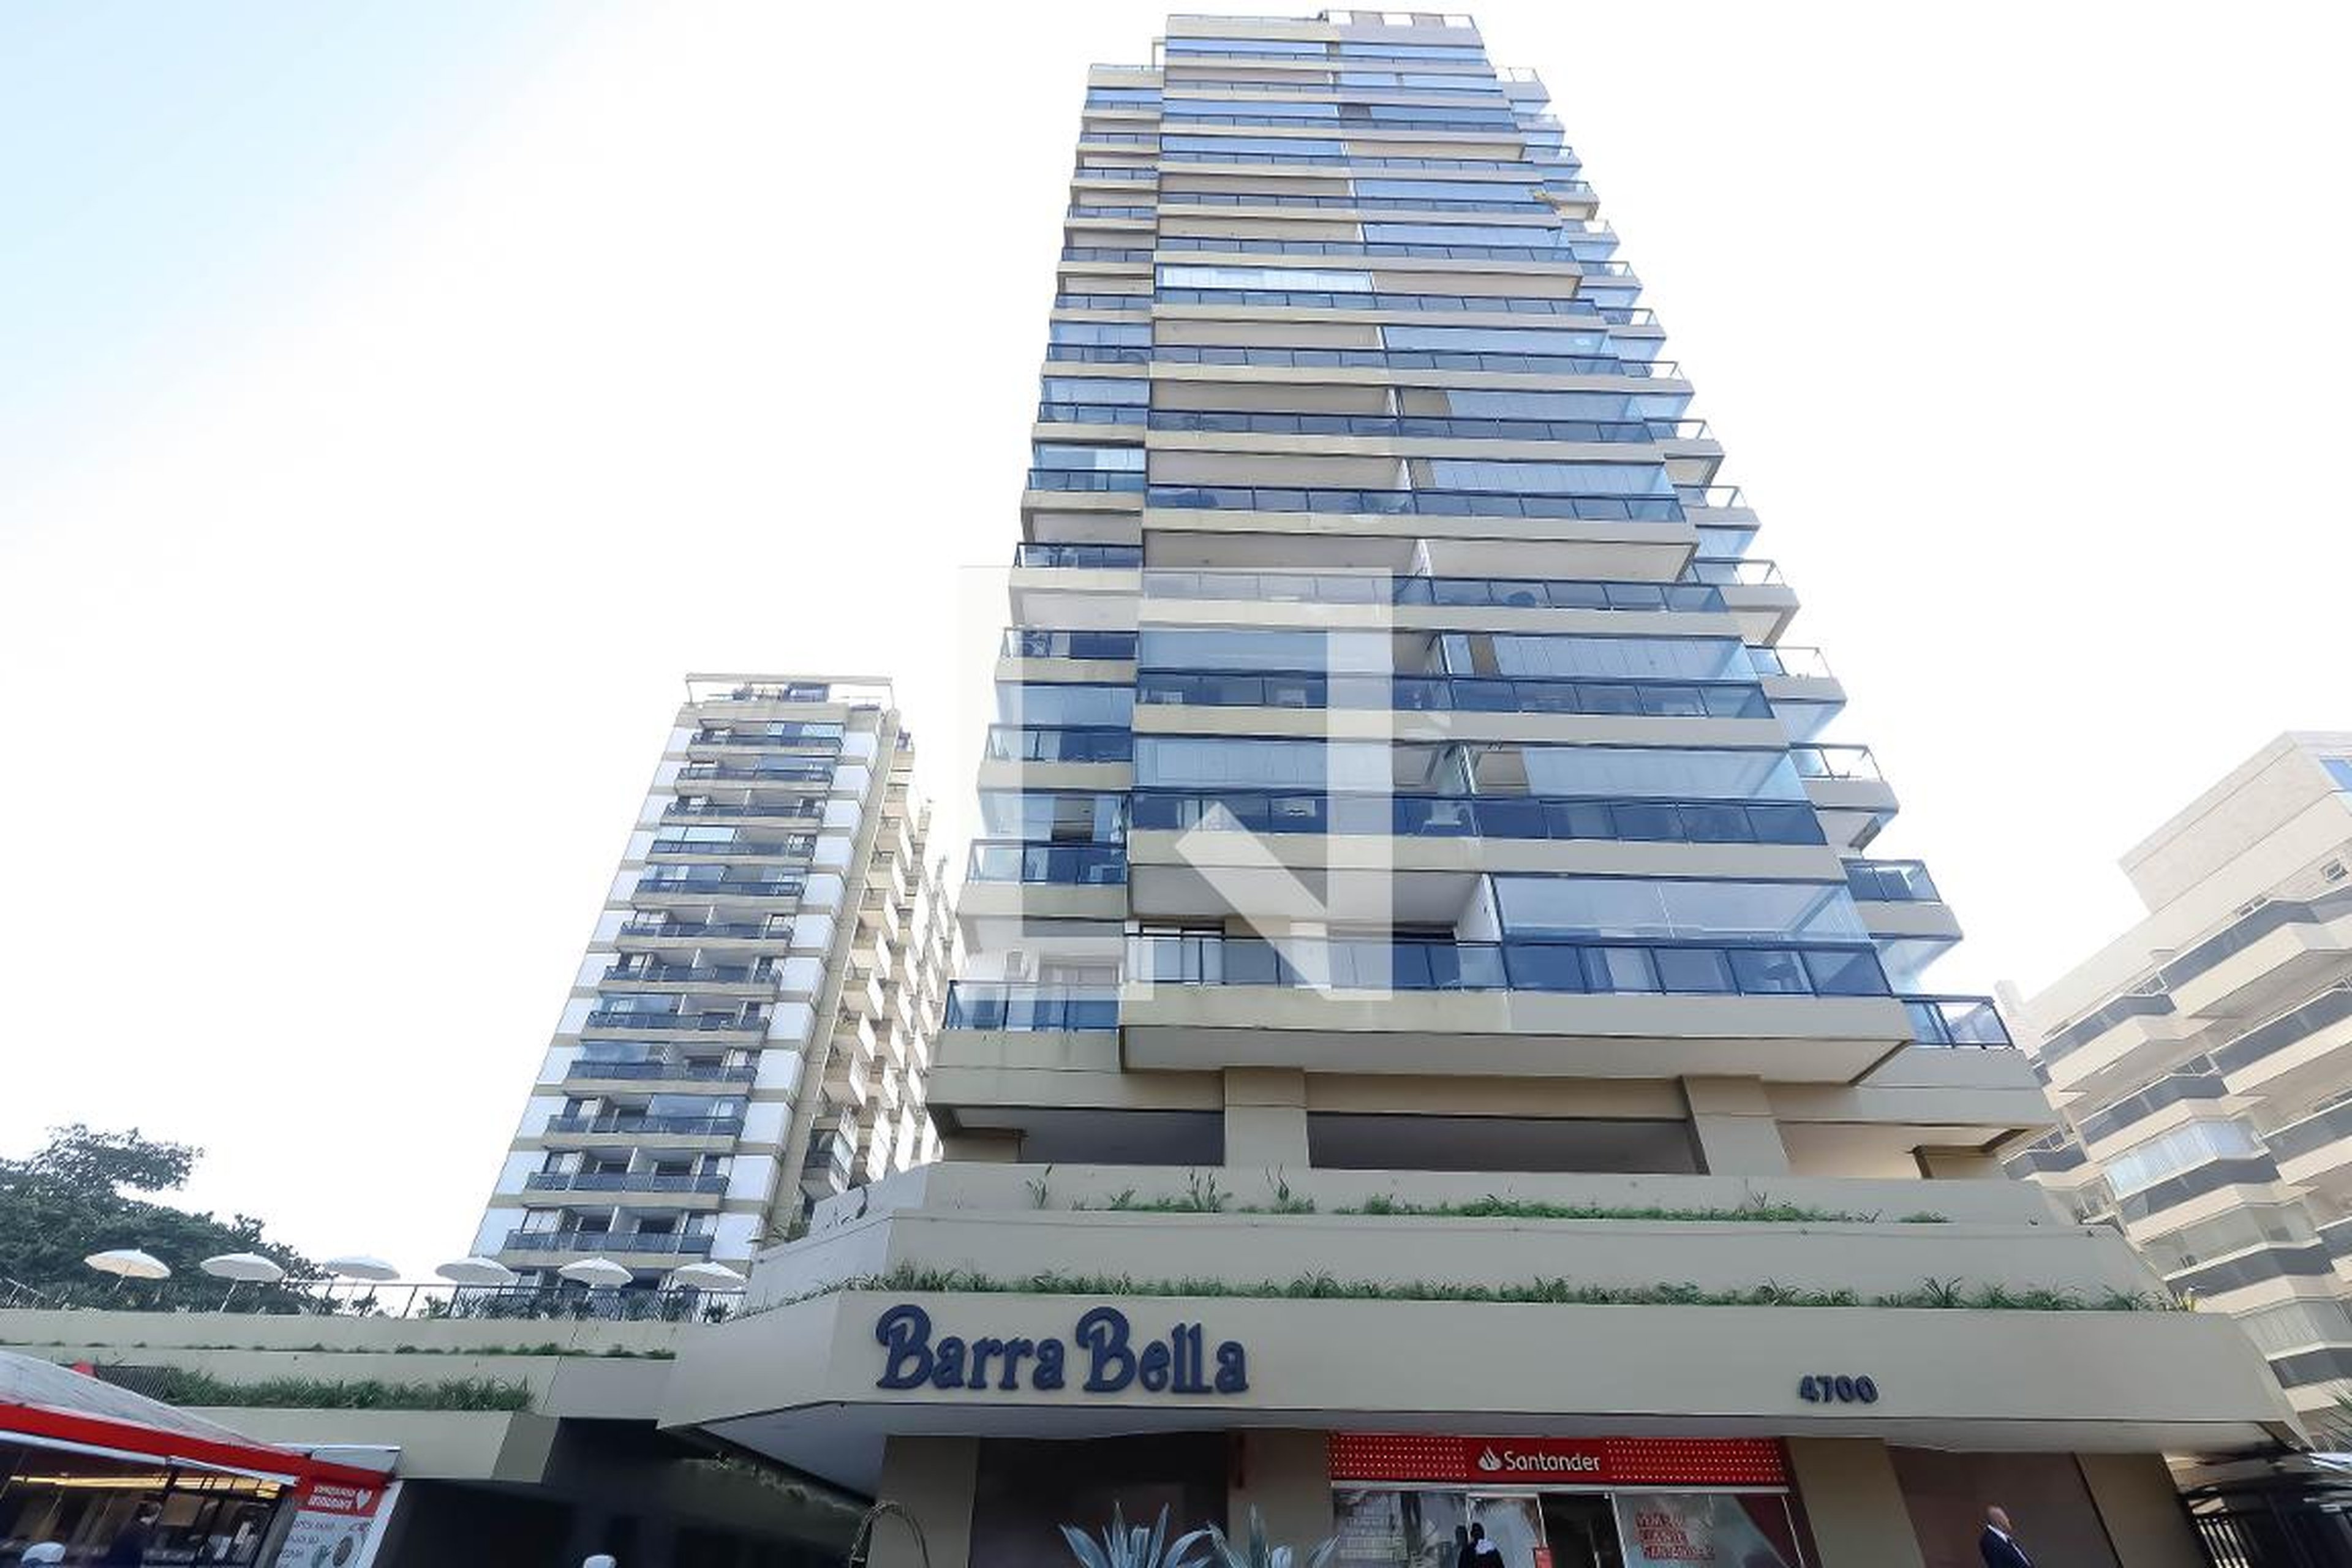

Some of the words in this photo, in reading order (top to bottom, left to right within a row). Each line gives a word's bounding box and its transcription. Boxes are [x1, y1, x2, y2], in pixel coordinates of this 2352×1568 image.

[876, 1305, 1065, 1389] Barra
[1076, 1306, 1249, 1393] Bella
[1800, 1374, 1879, 1403] 4700
[1504, 1450, 1600, 1471] Santander
